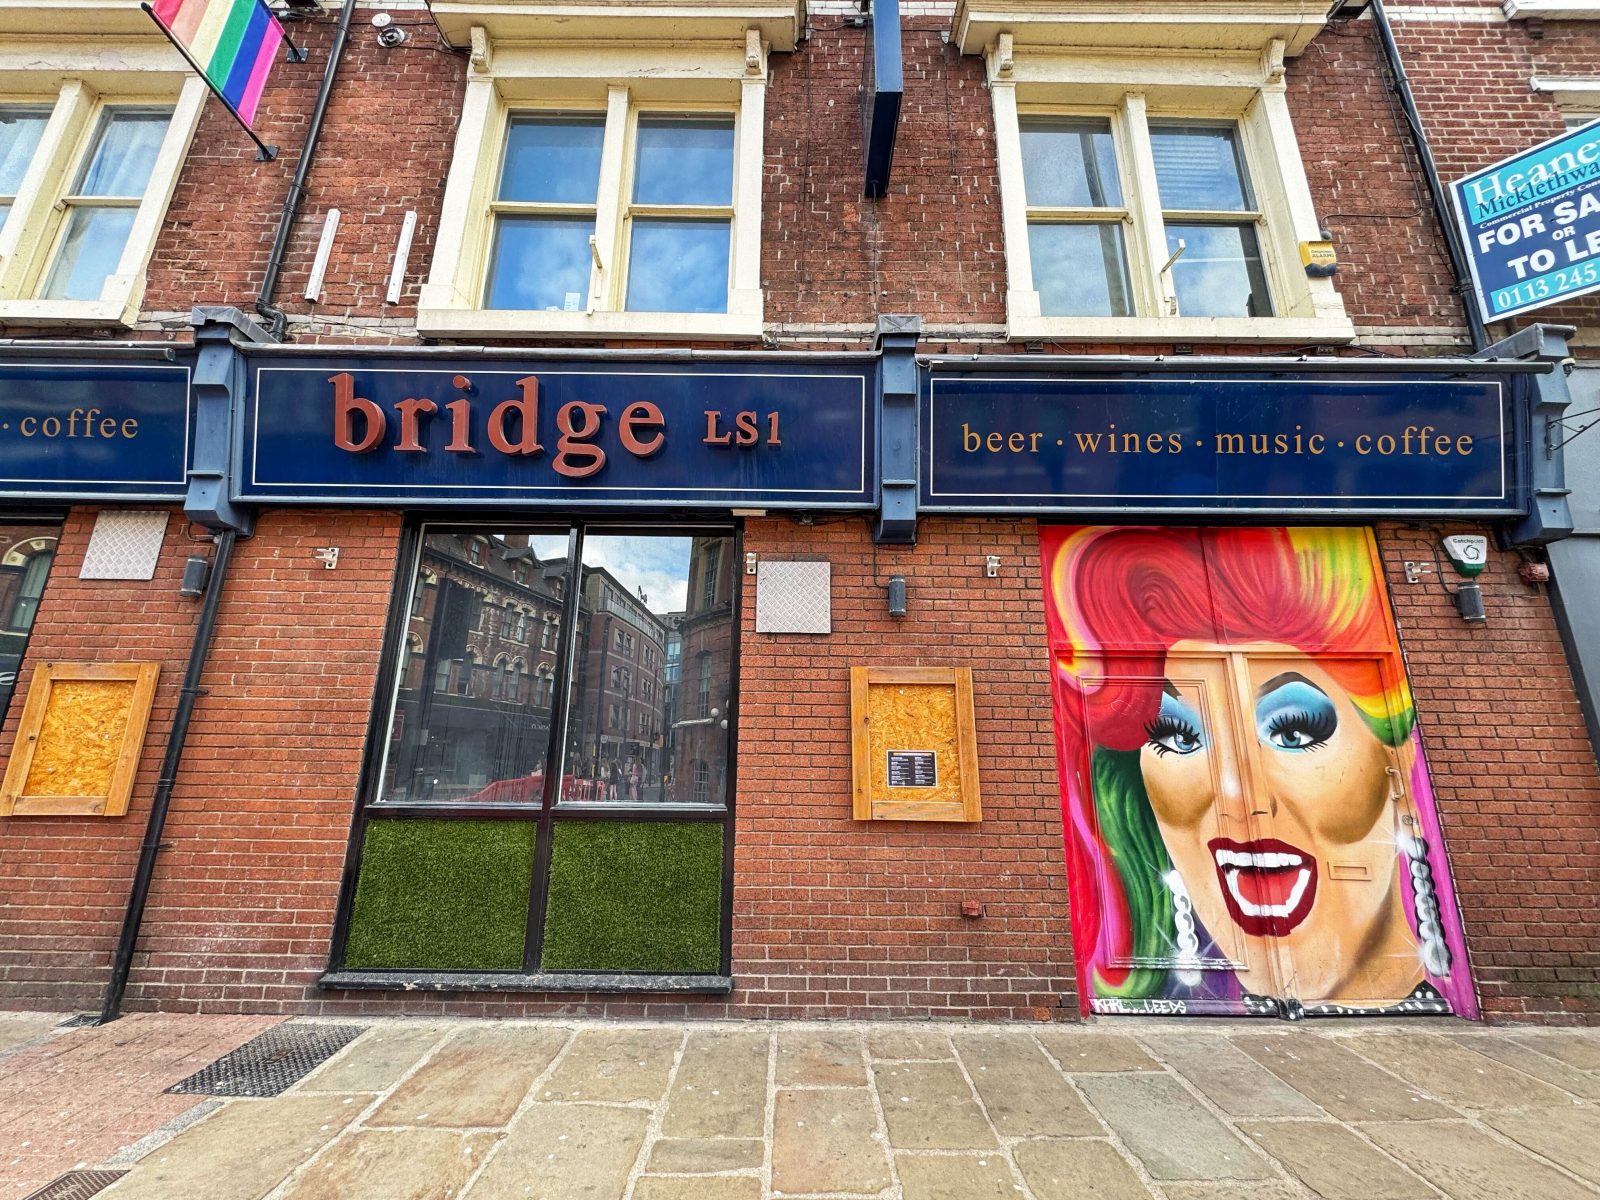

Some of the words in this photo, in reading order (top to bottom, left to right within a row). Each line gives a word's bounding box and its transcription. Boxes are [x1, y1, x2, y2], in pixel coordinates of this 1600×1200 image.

[1470, 139, 1600, 208] Heane
[1478, 161, 1600, 219] Micklethwa
[1477, 213, 1546, 254] FOR
[1553, 192, 1600, 225] SA
[1479, 206, 1532, 229] Commercial
[1535, 190, 1575, 209] Property
[1552, 225, 1576, 241] OR
[1507, 249, 1555, 280] TO
[1564, 229, 1600, 262] LE
[1498, 279, 1549, 308] 0113
[1555, 263, 1597, 292] 245
[20, 408, 138, 439] coffee
[327, 372, 667, 478] bridge
[703, 410, 782, 447] LS1
[962, 423, 1043, 453] beer
[1074, 424, 1182, 454] wines
[1214, 425, 1326, 455] music
[1355, 425, 1474, 456] coffee
